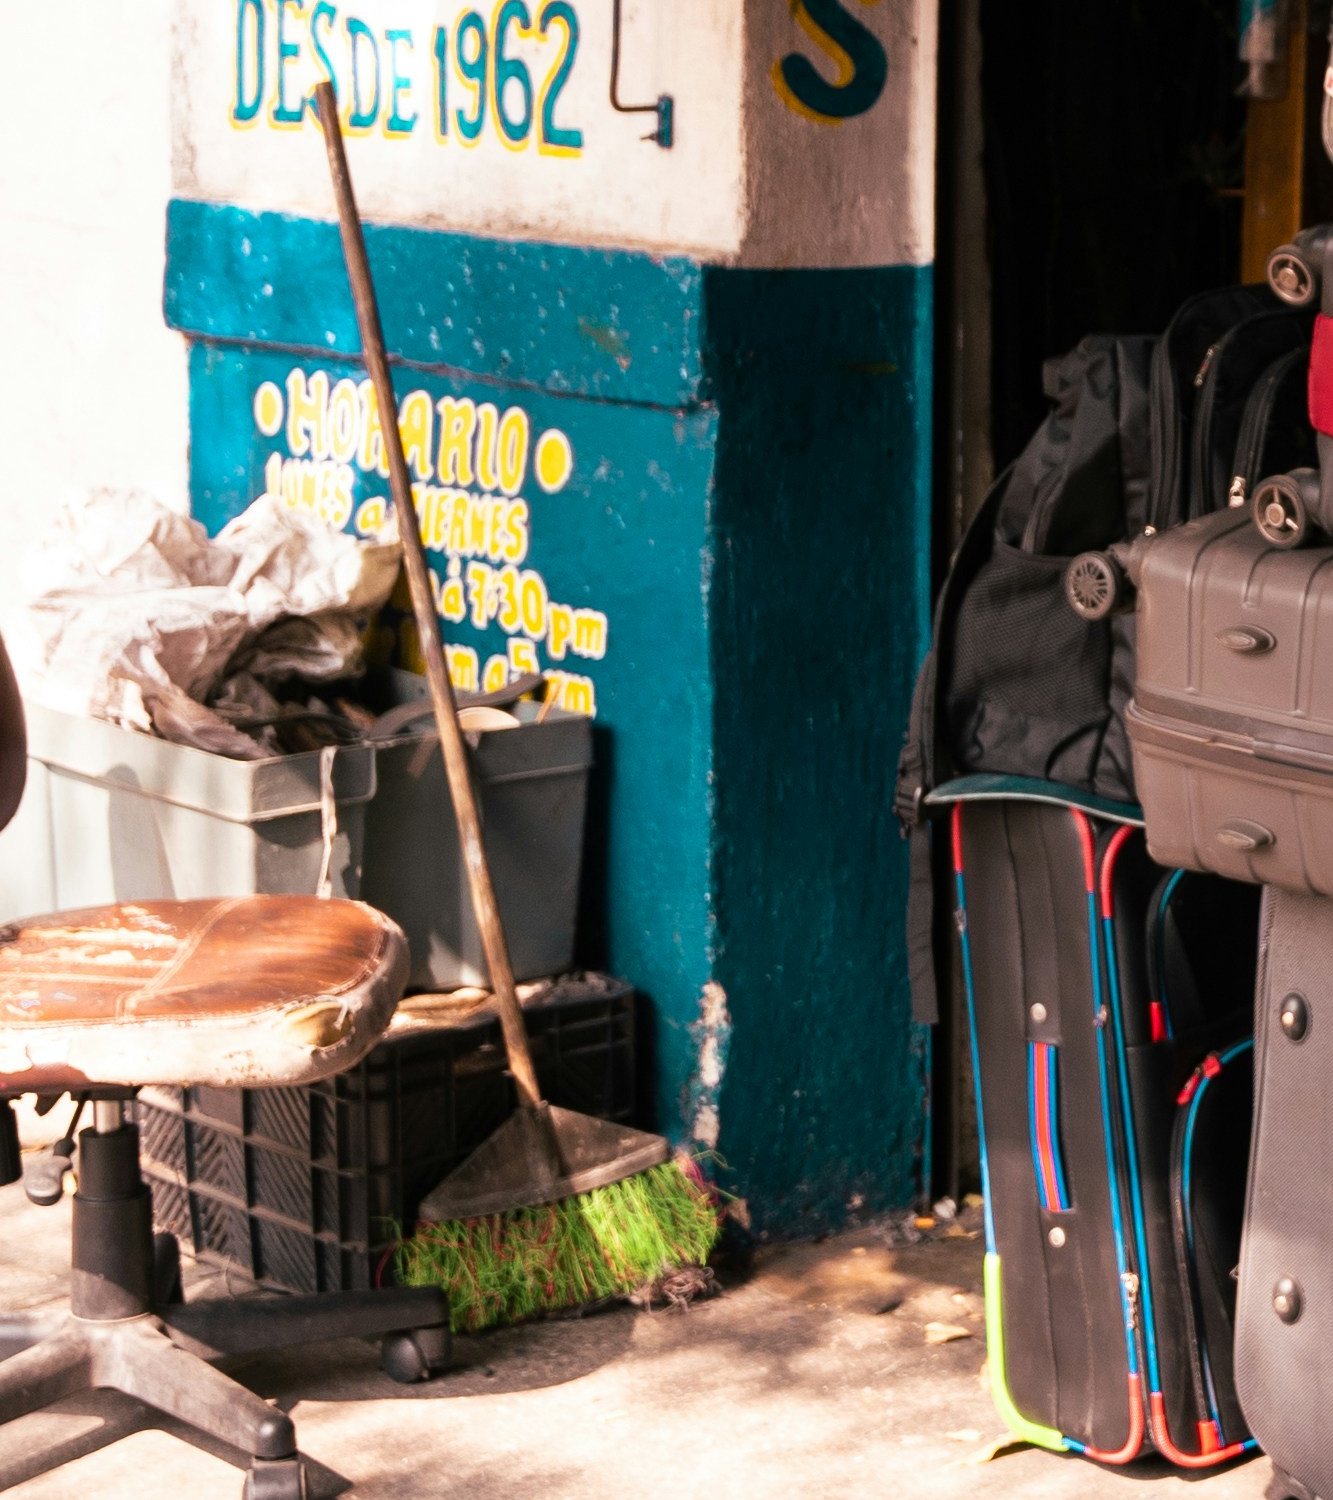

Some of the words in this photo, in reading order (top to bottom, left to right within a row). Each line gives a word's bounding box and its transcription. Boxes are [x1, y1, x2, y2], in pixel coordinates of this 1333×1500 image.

[285, 367, 530, 496] HORARIO
[467, 560, 549, 641] 7:30
[546, 601, 608, 661] pm
